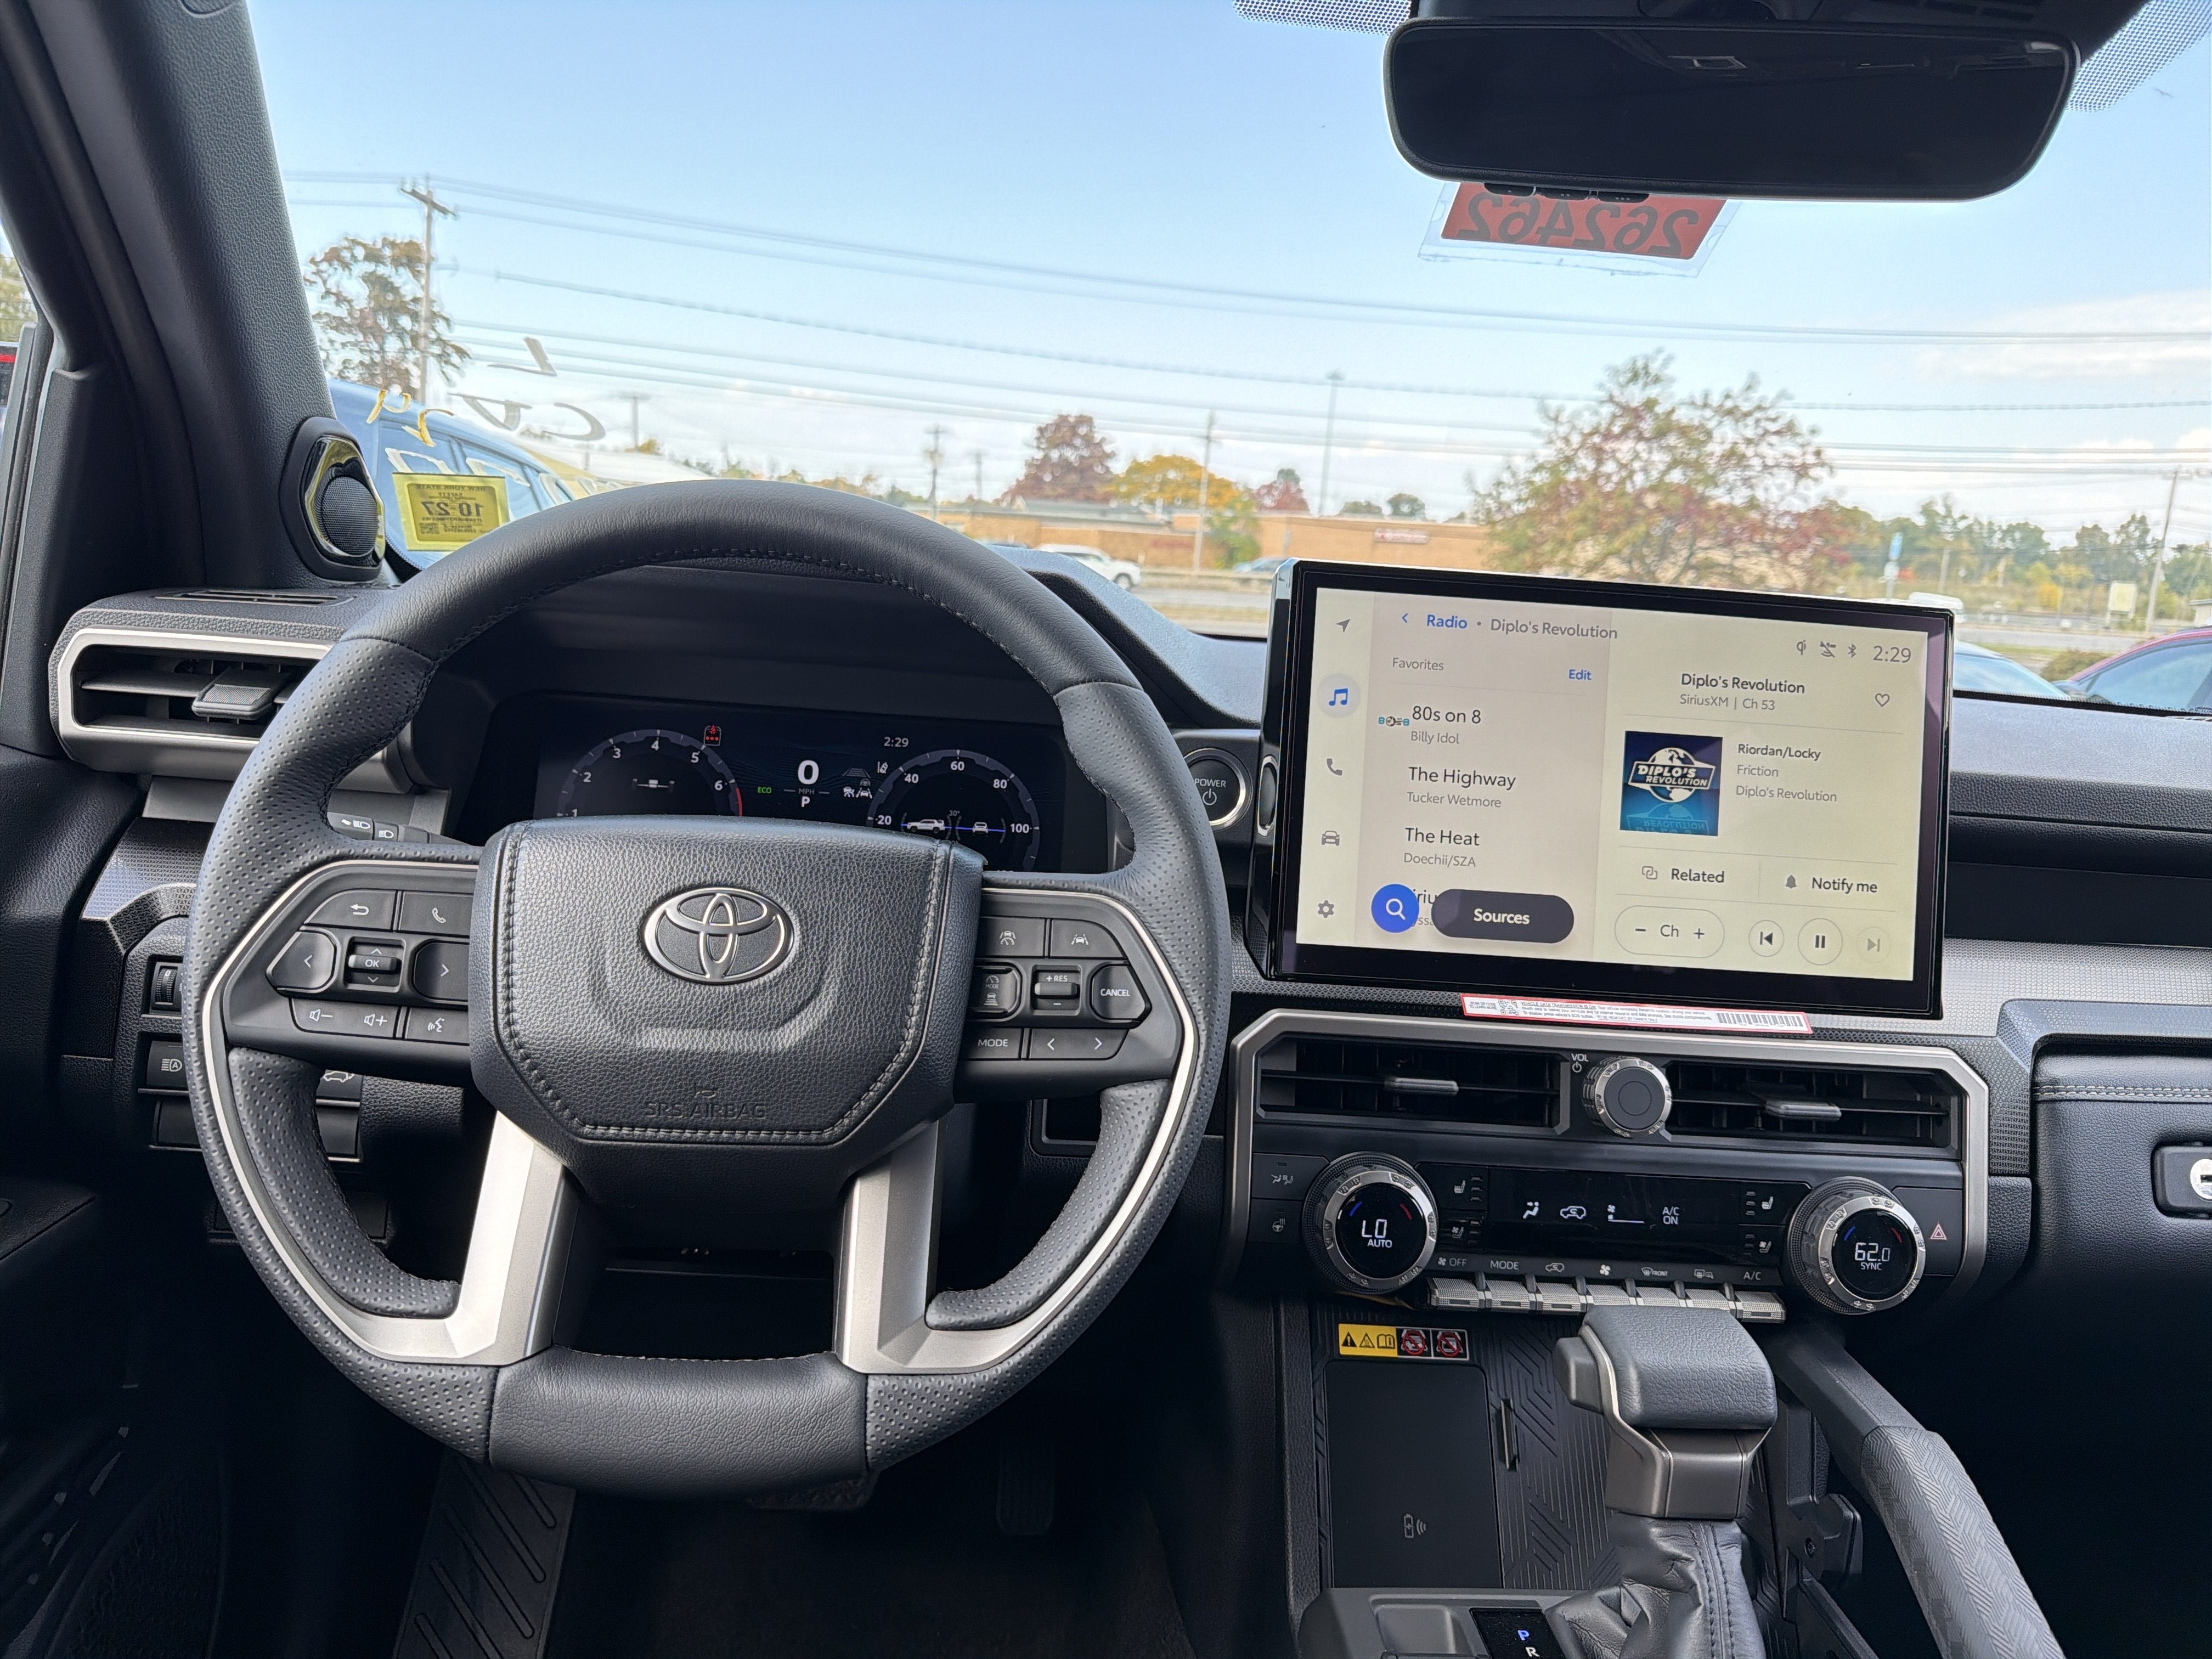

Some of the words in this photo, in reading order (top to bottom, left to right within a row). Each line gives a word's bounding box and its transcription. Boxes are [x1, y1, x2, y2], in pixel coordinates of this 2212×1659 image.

[1426, 614, 1468, 629] Radio
[1491, 619, 1538, 634] Diplo's
[1542, 622, 1618, 639] Revolution
[1873, 645, 1911, 663] 2:29
[1392, 657, 1444, 670] Favorites
[1568, 669, 1592, 681] Edit
[1681, 673, 1728, 689] Diplo's
[1732, 678, 1805, 694] Revolution
[1680, 693, 1728, 707] SiriusXM
[1742, 698, 1758, 709] Ch
[1761, 699, 1775, 710] 53
[1412, 706, 1441, 721] 80s
[1445, 712, 1466, 723] on
[1471, 709, 1481, 724] 8
[883, 736, 909, 748] 2:29
[1411, 731, 1434, 744] Billy
[1437, 733, 1459, 744] Idol
[651, 740, 659, 751] 4
[612, 748, 622, 759] 3
[691, 752, 699, 763] 5
[1738, 743, 1821, 761] Riordan/Locky
[950, 760, 965, 771] 60
[1737, 764, 1779, 777] Friction
[798, 760, 819, 785] 0
[1638, 765, 1697, 778] DIPLO'S
[583, 772, 592, 783] 2
[904, 774, 919, 784] 40
[1194, 778, 1226, 788] POWER
[1408, 766, 1438, 782] The
[1443, 769, 1516, 791] Highway
[1646, 775, 1708, 786] REVOLUTION
[714, 780, 723, 791] 6
[993, 778, 1007, 789] 80
[1736, 785, 1774, 799] Diplo's
[1777, 788, 1837, 802] Revolution
[801, 796, 810, 808] P
[1407, 792, 1444, 804] Tucker
[1447, 794, 1502, 808] Wetmore
[572, 809, 578, 817] 1
[878, 815, 892, 826] 20
[1010, 823, 1029, 833] 100
[1405, 827, 1435, 843] The
[1440, 830, 1480, 846] Heat
[1404, 853, 1476, 867] Doechii/SZA
[1671, 868, 1724, 883] Related
[1812, 877, 1853, 894] Notify
[1856, 882, 1877, 893] me
[1474, 908, 1530, 925] Sources
[1660, 924, 1679, 938] Ch
[365, 960, 379, 968] OK
[1100, 988, 1130, 997] CANCEL
[978, 1039, 1008, 1047] MODE
[1571, 1053, 1589, 1062] VOL
[690, 1103, 767, 1120] AIRBAG
[1662, 1206, 1679, 1216] A/C
[1663, 1215, 1678, 1225] ON
[1367, 1239, 1392, 1249] AUTO
[1854, 1242, 1890, 1262] 62.0
[1449, 1257, 1467, 1267] OFF
[1490, 1260, 1519, 1270] MODE
[1860, 1262, 1882, 1271] SYNC
[1743, 1271, 1762, 1281] A/C
[1517, 1629, 1530, 1640] P
[1525, 1647, 1540, 1657] R
